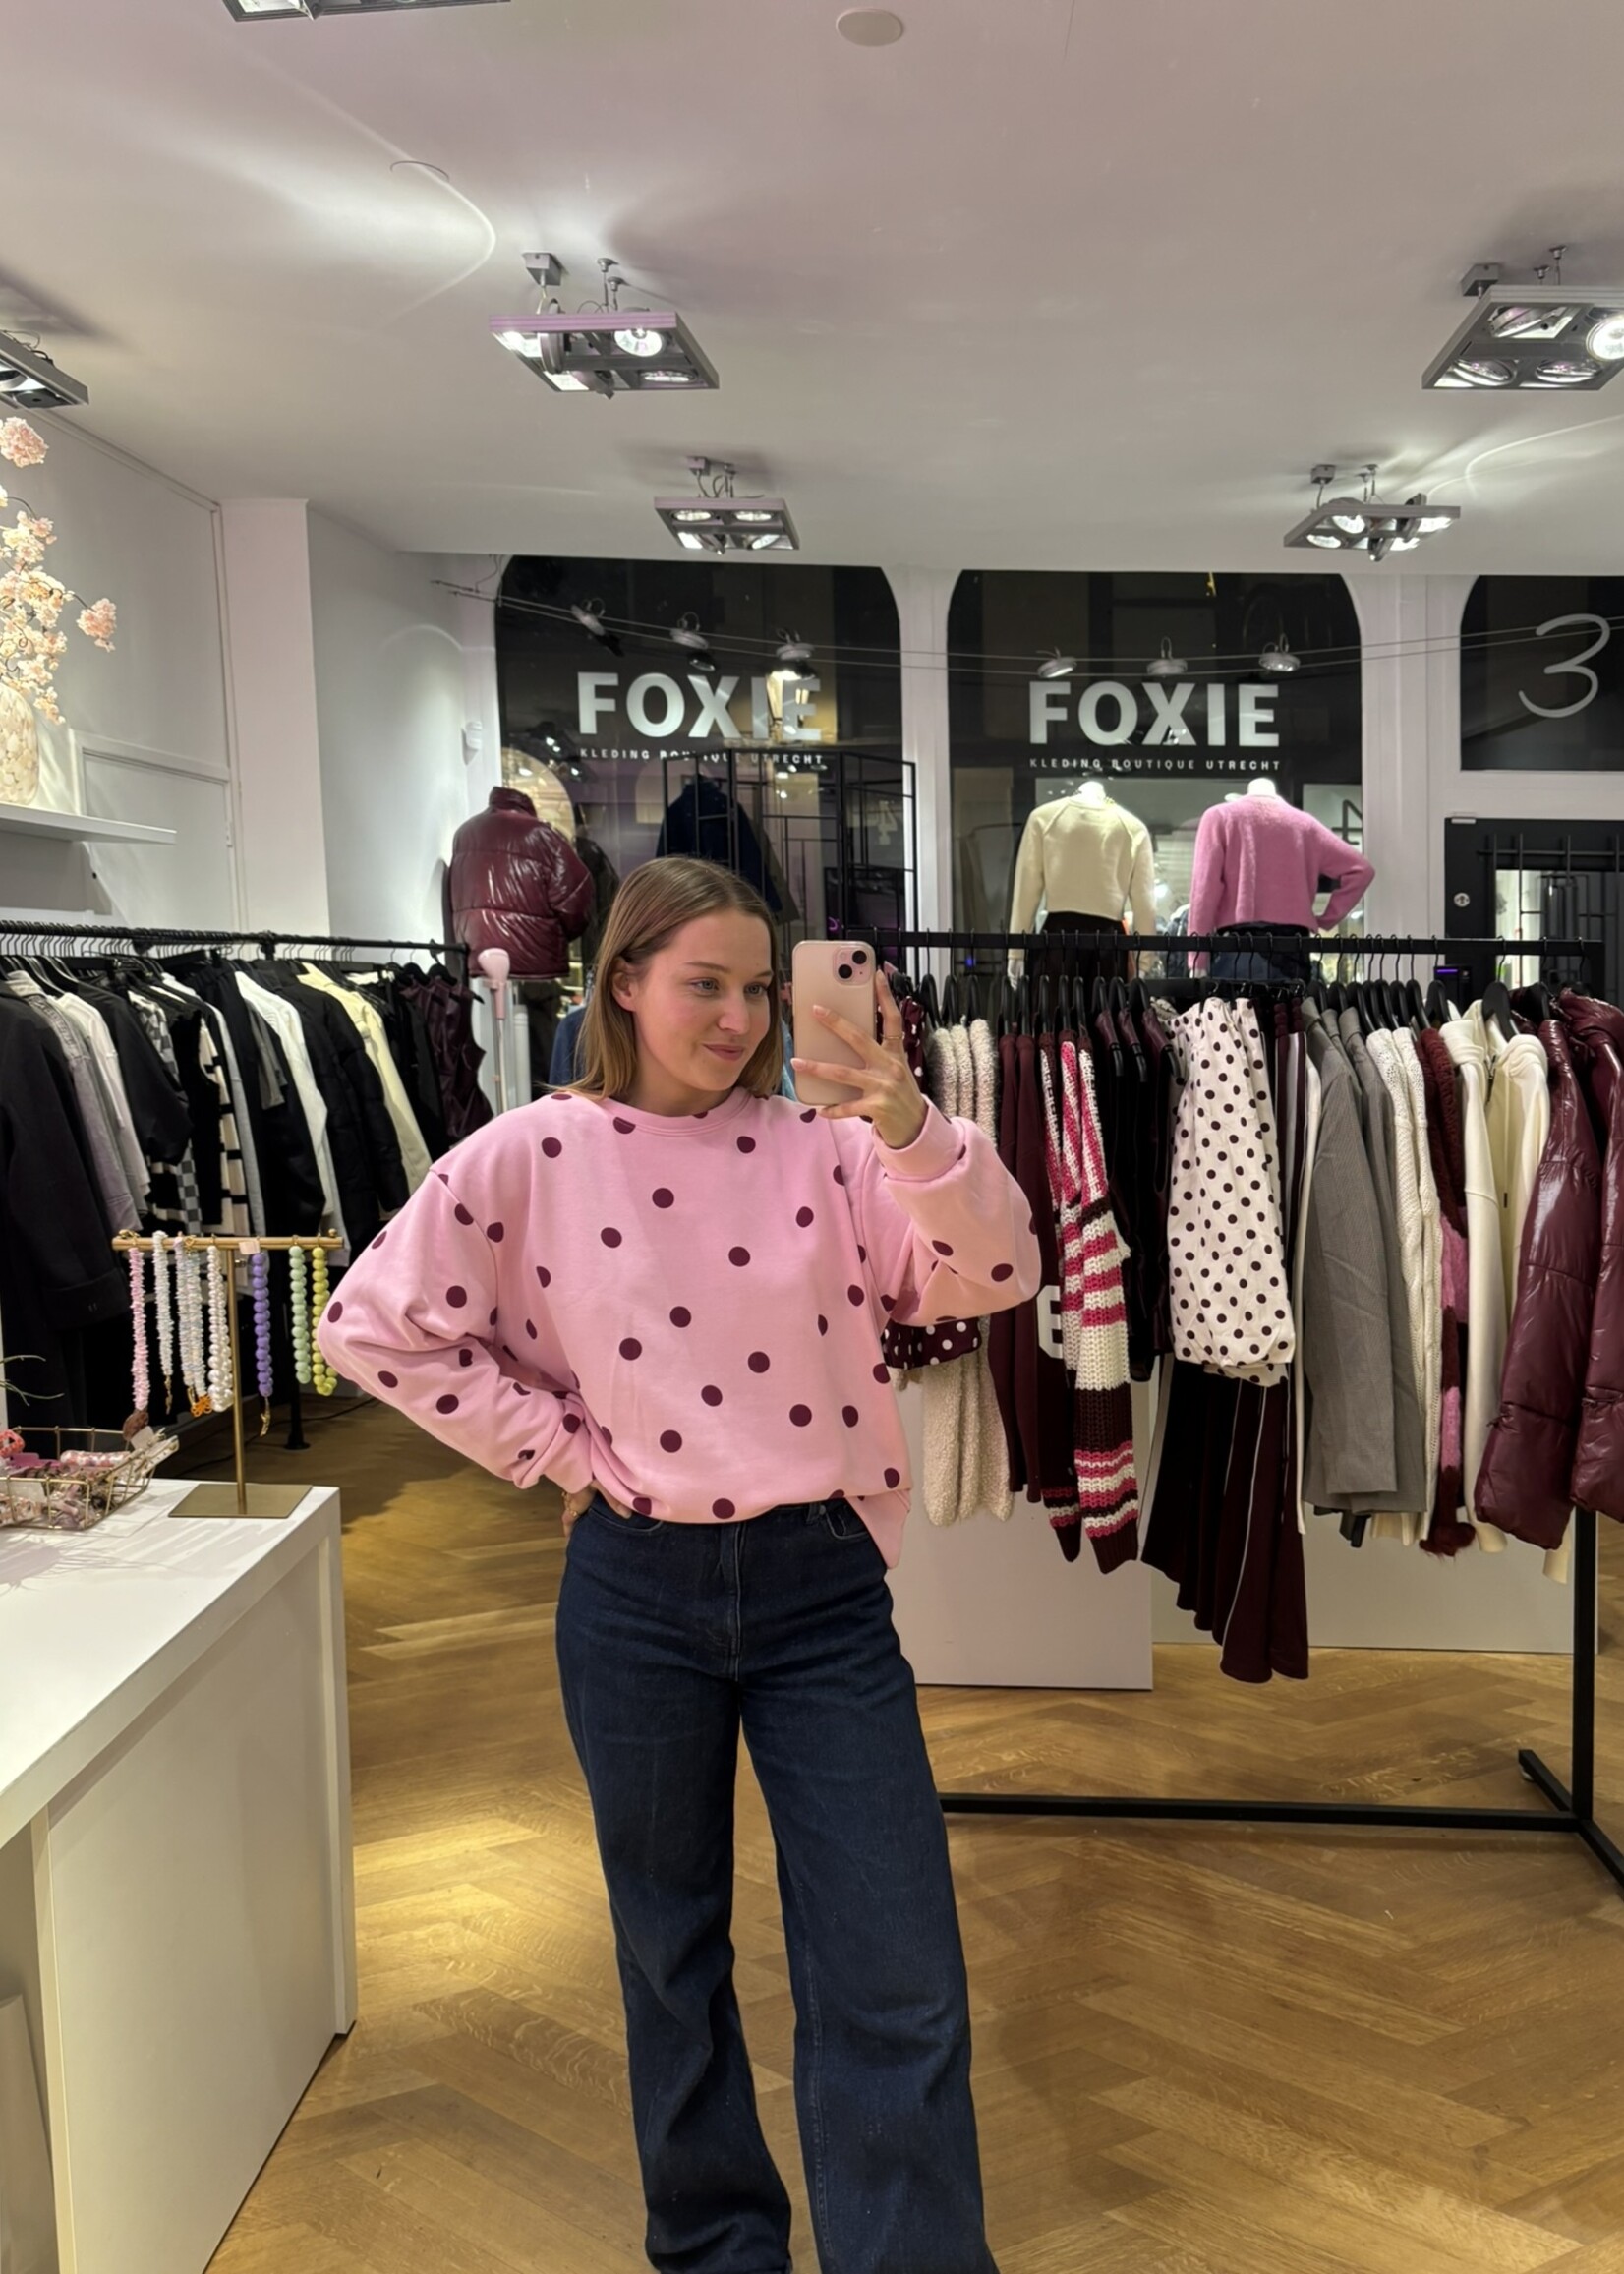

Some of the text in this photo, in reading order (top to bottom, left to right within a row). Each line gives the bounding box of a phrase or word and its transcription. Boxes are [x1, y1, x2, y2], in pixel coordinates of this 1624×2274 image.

[1519, 613, 1610, 718] 3
[578, 671, 822, 741] FOXIE
[1029, 680, 1280, 747] FOXIE
[580, 748, 650, 760] KLEDING
[750, 752, 823, 765] UTRECHT
[1030, 758, 1280, 771] KLEDING BOUTIQUE UTRECHT
